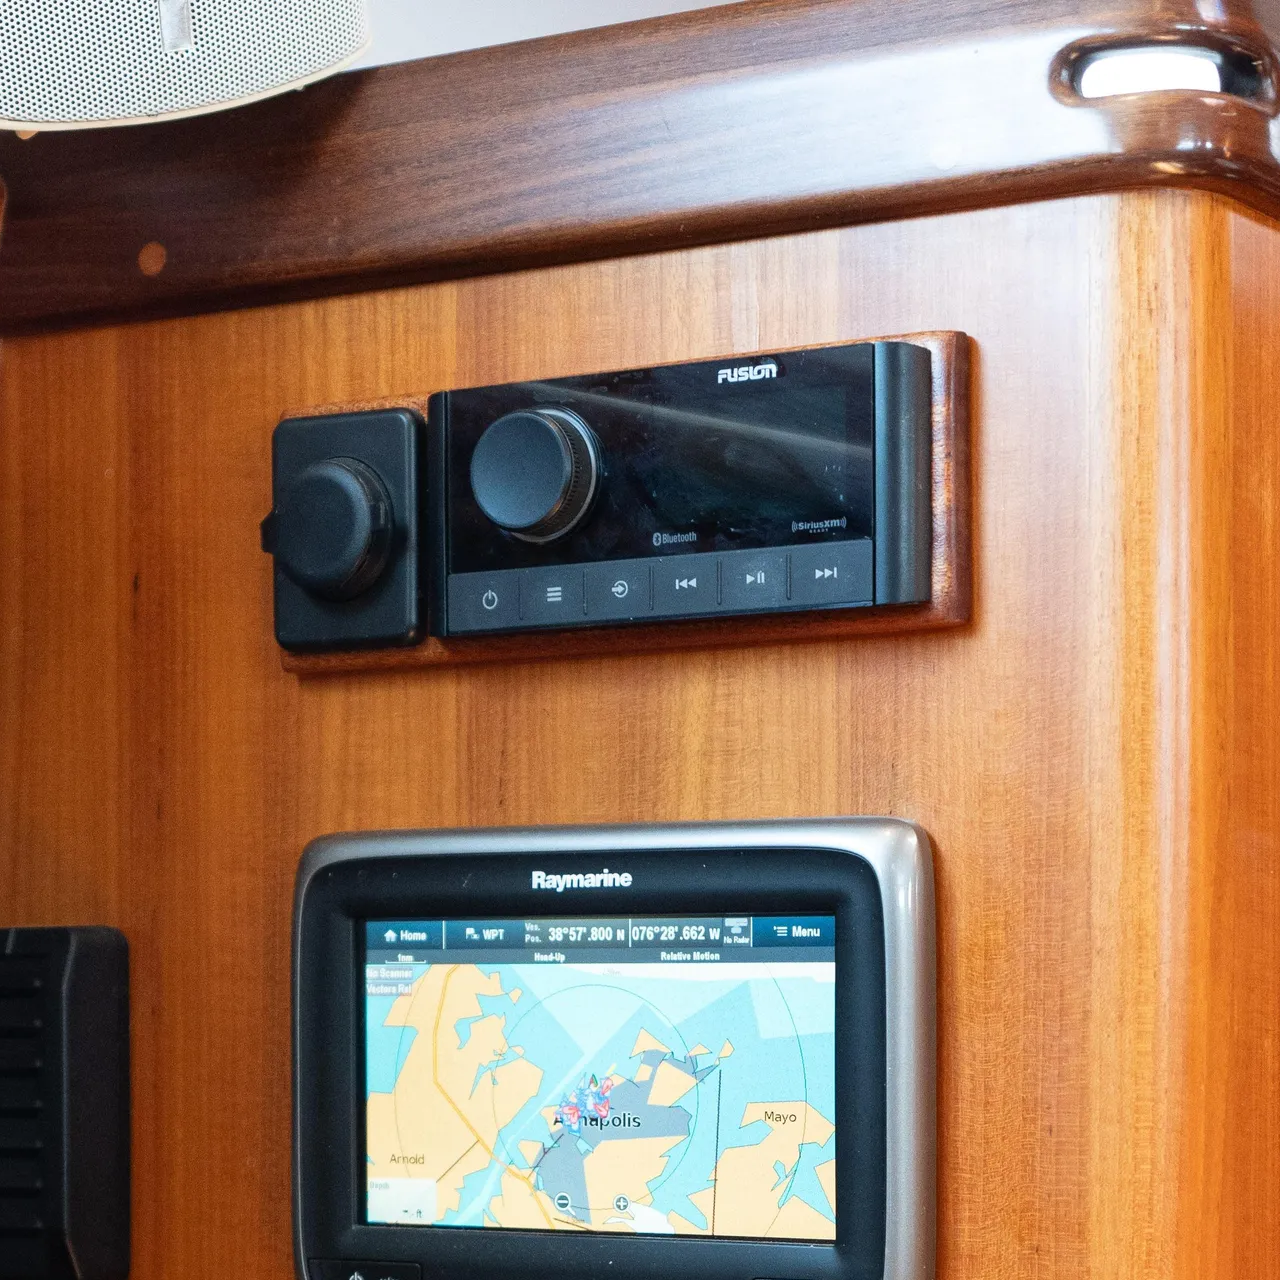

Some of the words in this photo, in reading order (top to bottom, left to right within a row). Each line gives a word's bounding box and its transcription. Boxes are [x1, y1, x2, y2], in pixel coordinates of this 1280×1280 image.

[718, 364, 777, 384] FUSION
[662, 531, 697, 544] Bluetooth
[532, 869, 632, 892] Raymarine
[400, 930, 427, 941] Home
[483, 929, 505, 940] WPT
[617, 929, 625, 940] N
[709, 928, 720, 940] W
[792, 927, 820, 938] Menu
[534, 952, 565, 963] Head-Up
[661, 951, 691, 961] Relative
[693, 951, 720, 961] Motion
[764, 1111, 797, 1125] Mayo
[389, 1153, 425, 1165] Arnold
